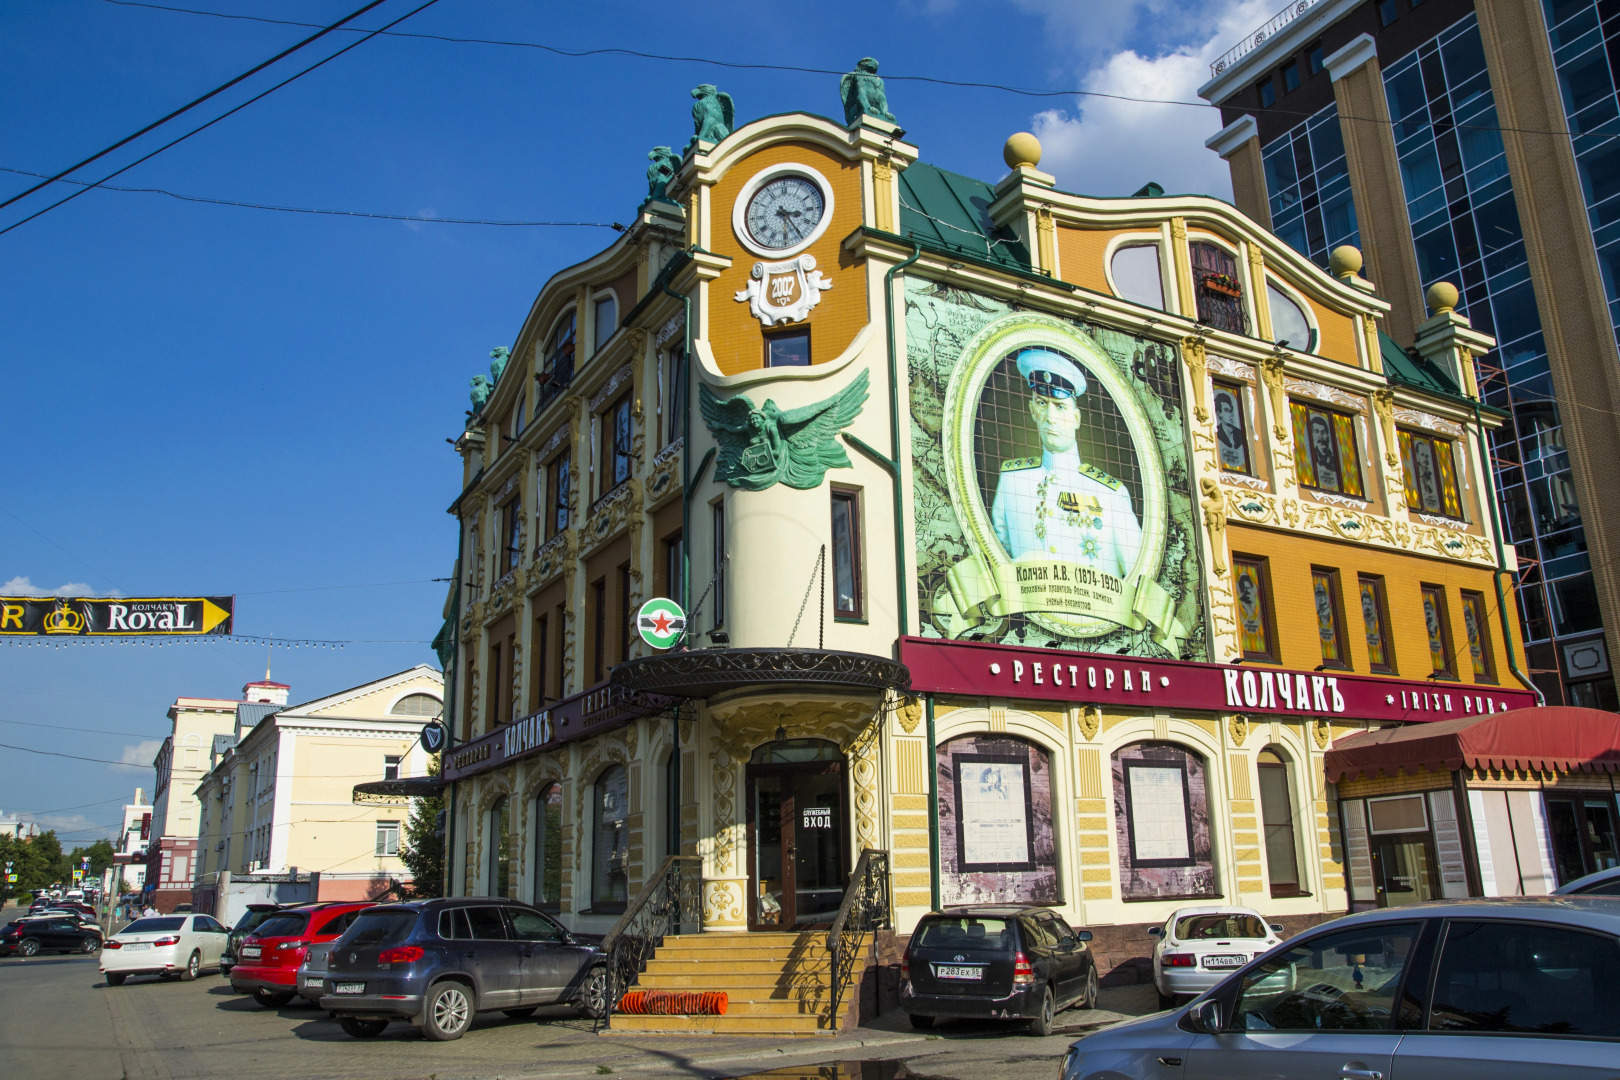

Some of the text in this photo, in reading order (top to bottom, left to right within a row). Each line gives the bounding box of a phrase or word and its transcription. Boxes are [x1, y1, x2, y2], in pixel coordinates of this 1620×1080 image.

[771, 276, 795, 299] 2007
[1015, 565, 1123, 595] Колчак А.В. (1874-1920)
[1020, 584, 1047, 594] Верховный
[1048, 584, 1072, 595] правитель
[1, 605, 25, 629] R
[1013, 659, 1152, 694] РЕСТОРАН
[1223, 668, 1346, 713] КОЛЧАКЪ
[1401, 690, 1494, 714] IRISH PUB
[504, 710, 552, 759] КОЛЧАКЪ
[804, 816, 830, 828] ВХОД
